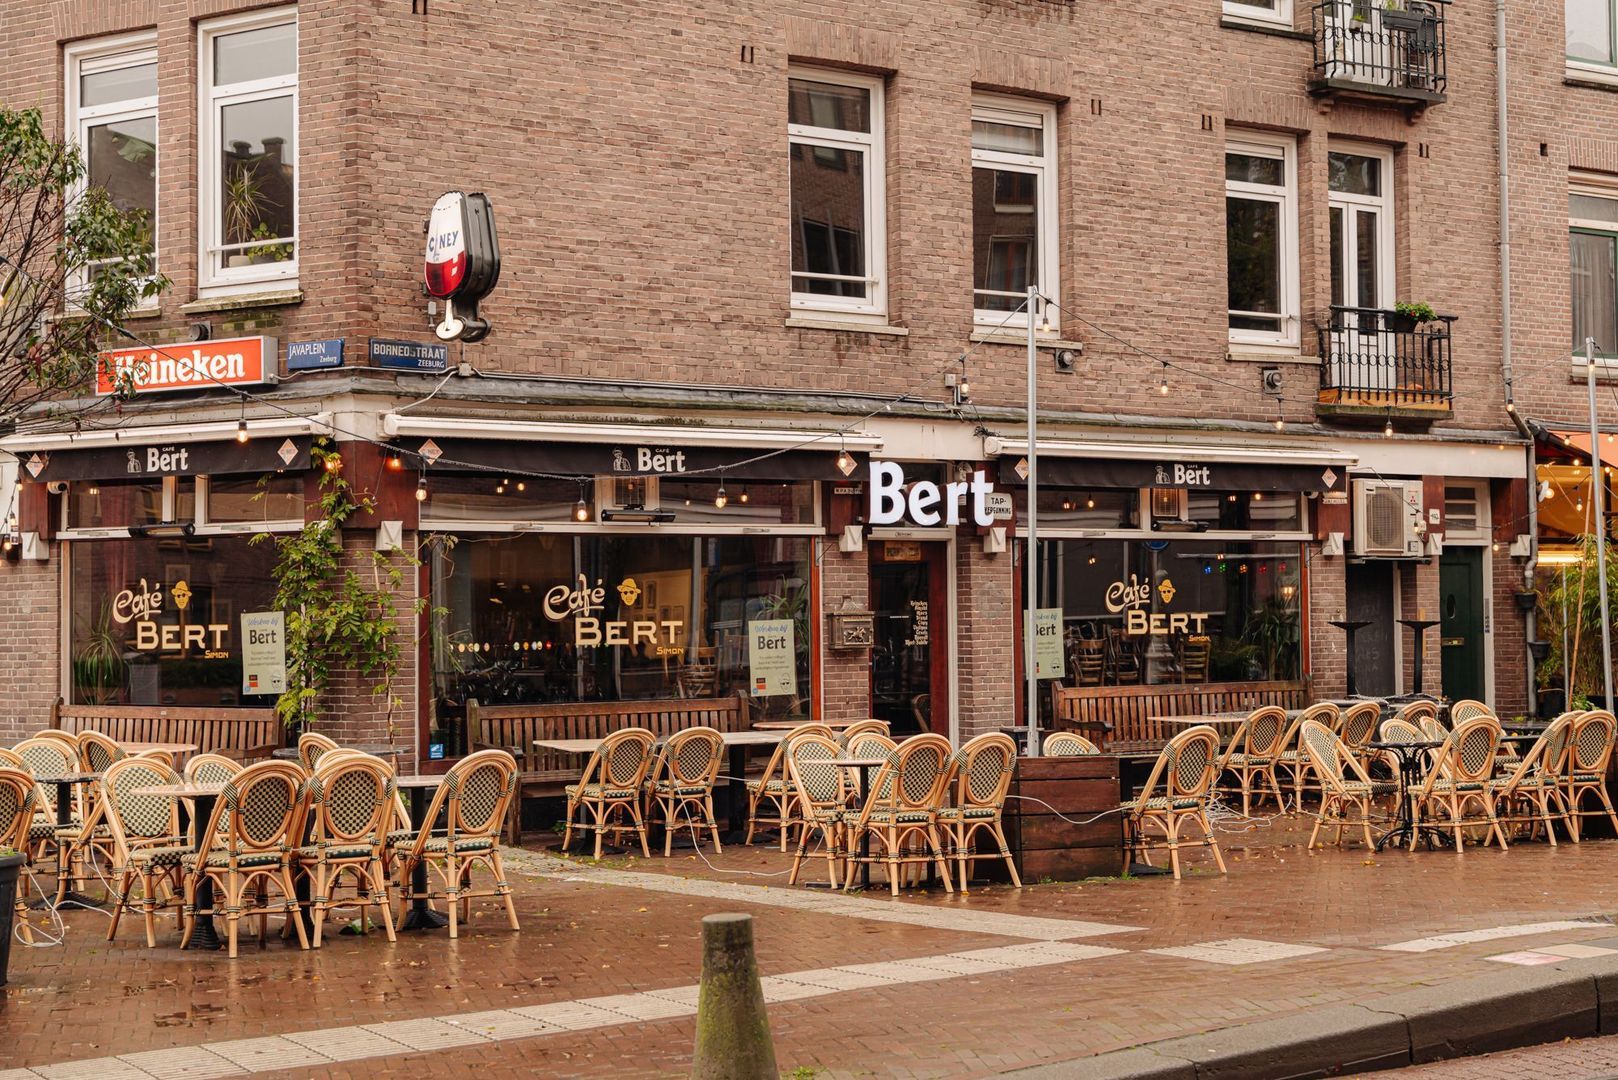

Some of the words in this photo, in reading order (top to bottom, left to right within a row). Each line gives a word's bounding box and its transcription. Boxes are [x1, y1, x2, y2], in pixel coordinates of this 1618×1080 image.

[289, 342, 326, 359] JAVAPLEIN
[319, 355, 338, 364] Zeeburg
[373, 343, 446, 360] BORNEOSTRAAT
[114, 350, 246, 388] Heineken
[417, 359, 446, 369] ZEEBURG
[146, 447, 189, 473] Bert
[637, 447, 686, 472] Bert
[1173, 463, 1211, 486] Bert
[869, 460, 994, 528] Bert
[113, 577, 163, 624] Café
[543, 573, 606, 621] Café
[1105, 573, 1151, 614] Café
[575, 617, 683, 646] BERT
[1128, 609, 1209, 635] BERT
[137, 621, 229, 650] BERT
[249, 629, 277, 645] Bert
[757, 635, 786, 650] Bert
